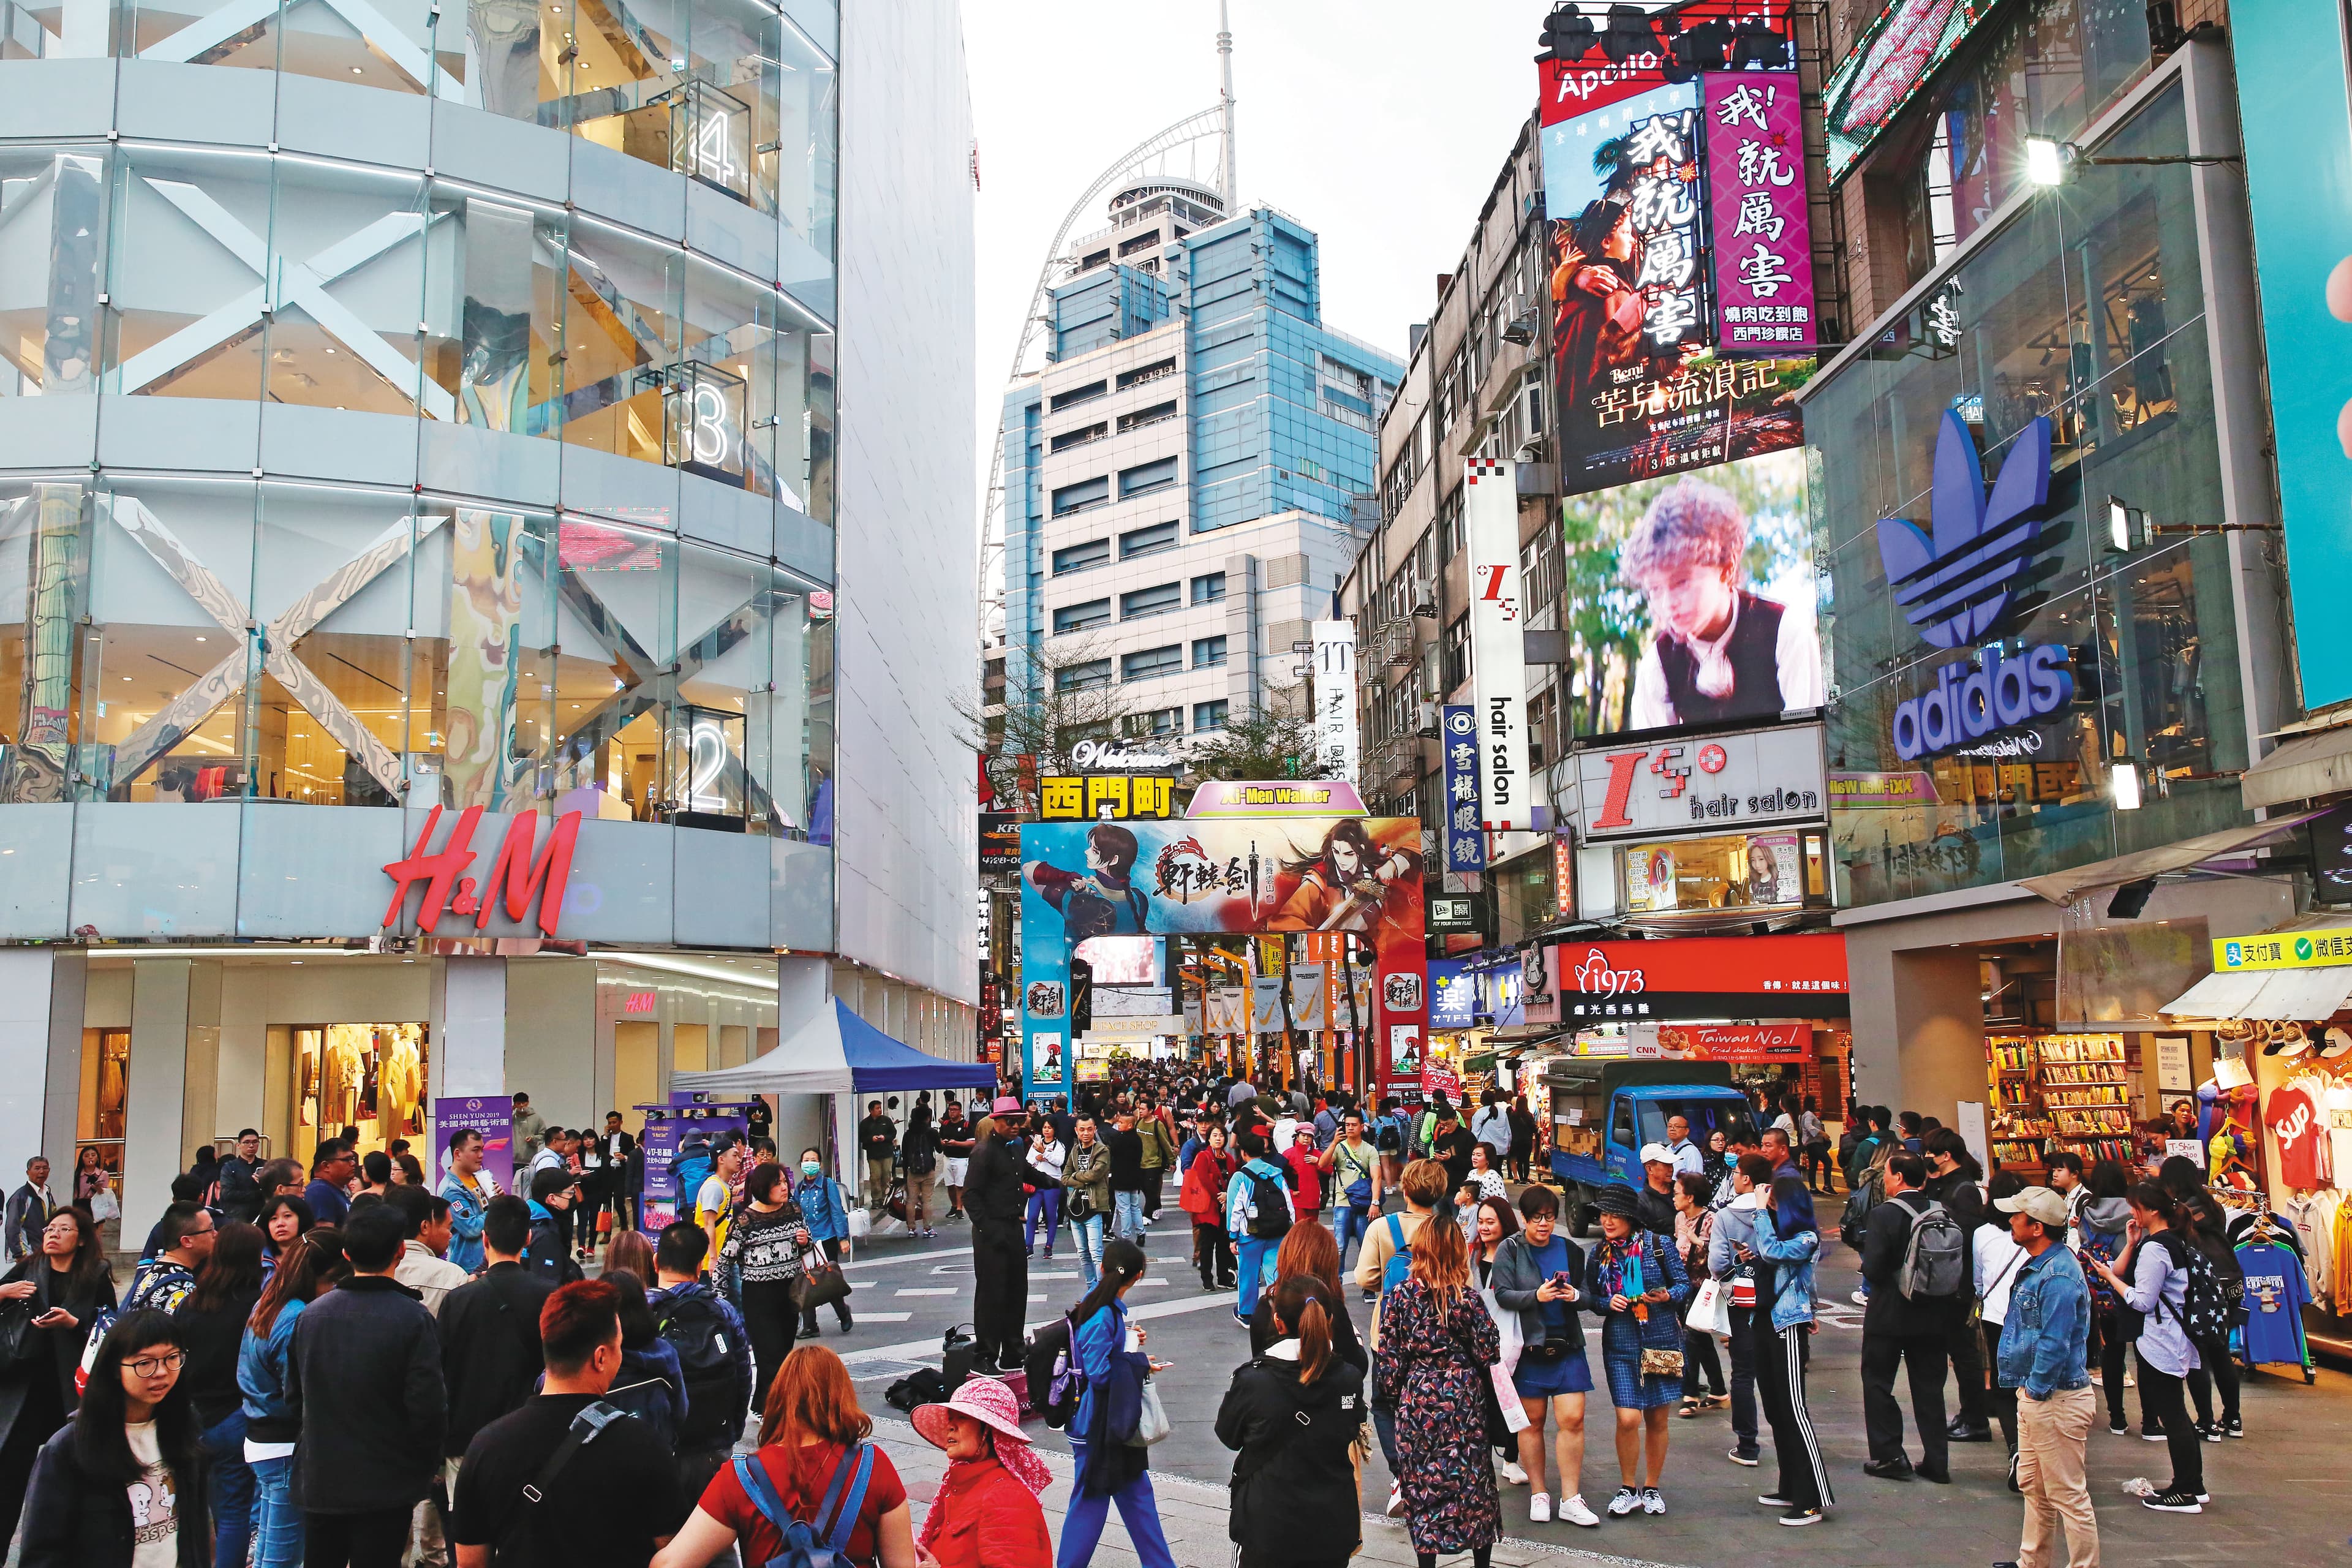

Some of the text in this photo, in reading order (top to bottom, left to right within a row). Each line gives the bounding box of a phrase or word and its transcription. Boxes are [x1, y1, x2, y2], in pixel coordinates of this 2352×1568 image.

[690, 111, 735, 187] 4
[1725, 306, 1808, 322] 燒肉吃到飽
[1733, 327, 1803, 341] 西門珍饌店
[1591, 358, 1779, 428] 苦兒流浪記
[687, 382, 728, 465] 3
[1651, 457, 1675, 470] 3/15
[1329, 688, 1343, 733] HAIR
[1893, 644, 2073, 761] adidas
[1071, 739, 1174, 769] Welcome
[1490, 697, 1515, 805] hair salon
[684, 723, 726, 810] 2
[1041, 777, 1175, 819] 西門町
[1220, 788, 1330, 805] Xi-Men Walker
[1450, 742, 1480, 864] 雪龍眼鏡
[1690, 788, 1817, 819] hair salon
[381, 804, 582, 936] H&M
[2244, 942, 2282, 962] 支付寶
[625, 992, 655, 1013] H&M
[1437, 987, 1465, 1011] 楽
[1101, 1021, 1128, 1030] FACE
[1129, 1020, 1159, 1030] SHOP
[1697, 1027, 1798, 1045] Taiwan No.1
[1424, 1068, 1455, 1079] Taiwan
[1431, 1076, 1456, 1086] No.1
[439, 1118, 509, 1128] 美國神韻藝術團
[2277, 1102, 2309, 1149] Sup
[2168, 1142, 2195, 1152] T-Shirt
